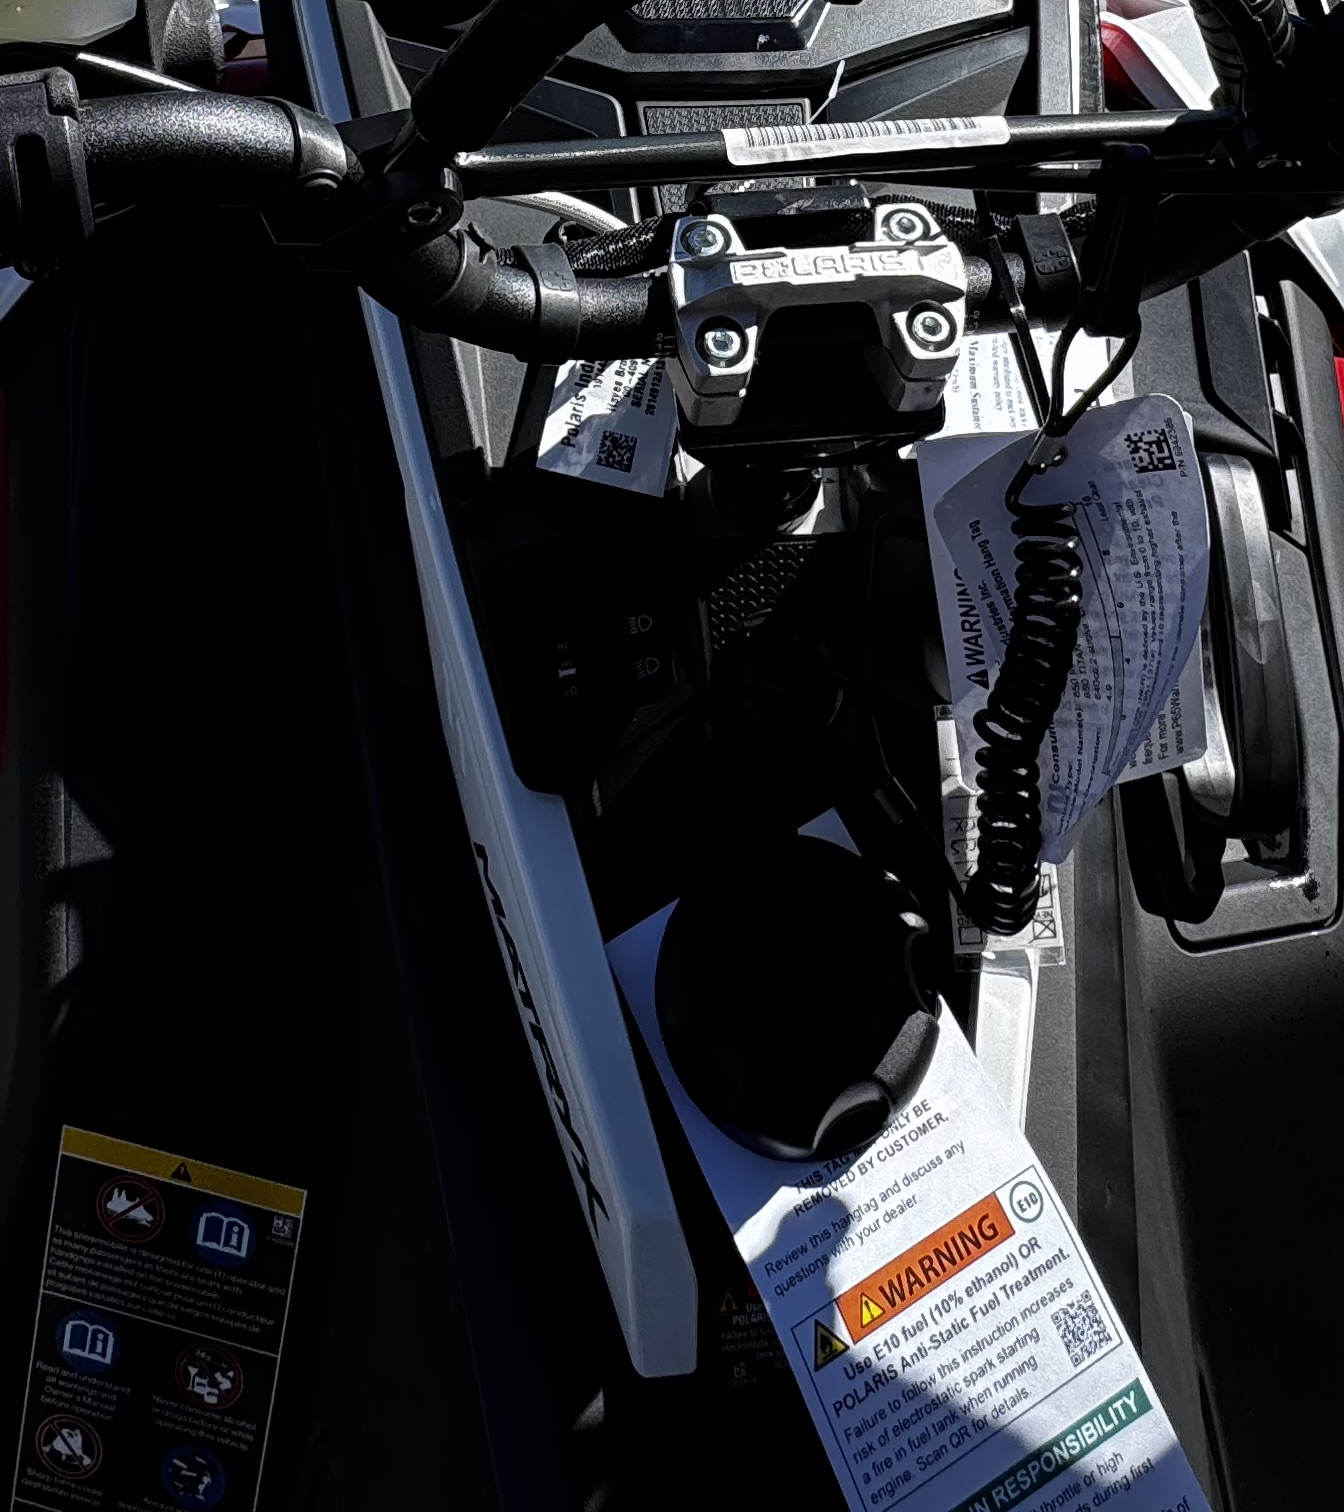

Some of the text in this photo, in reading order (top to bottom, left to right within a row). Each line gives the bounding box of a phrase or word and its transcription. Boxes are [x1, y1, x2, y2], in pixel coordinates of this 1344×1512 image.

[732, 252, 903, 280] POLARIS
[629, 368, 648, 408] SERIAL
[969, 340, 978, 388] Maximum
[560, 391, 586, 448] Polaris
[967, 518, 981, 541] Tag
[1082, 496, 1092, 506] 10
[977, 538, 997, 568] Hang
[1136, 534, 1144, 543] to
[1145, 527, 1159, 557] higher
[1073, 758, 1082, 793] Model
[1158, 742, 1168, 760] For
[473, 842, 610, 1239] MATRYX
[792, 1168, 857, 1218] REMOVED
[856, 1155, 877, 1176] BY
[875, 1107, 950, 1165] CUSTOMER.
[793, 1097, 932, 1196] THIS TAG ONLY BE
[763, 1139, 967, 1279] Review this hangtag and discuss any
[1015, 1189, 1040, 1215] E10
[772, 1251, 831, 1300] questions
[828, 1234, 856, 1260] with
[855, 1218, 884, 1246] your
[877, 1211, 1000, 1311] WARNING
[831, 1242, 1071, 1419] POLARIS Anti-Static Fuel Treatment.
[842, 1234, 1042, 1382] Use E10 fuel (10% ethanol) OR
[842, 1273, 1075, 1445] Failure to follow this instruction increases
[850, 1324, 1042, 1466] risk of electrostatic spark starting
[860, 1352, 1040, 1486] a fire in fuel tank when running
[914, 1438, 952, 1474] Scan
[949, 1424, 972, 1450] QR
[969, 1409, 992, 1434] for
[989, 1388, 1143, 1510] RESPONSIBILITY
[1081, 1469, 1097, 1488] or
[1095, 1448, 1126, 1480] high
[1089, 1453, 1155, 1512] during first
[1173, 1494, 1192, 1512] of
